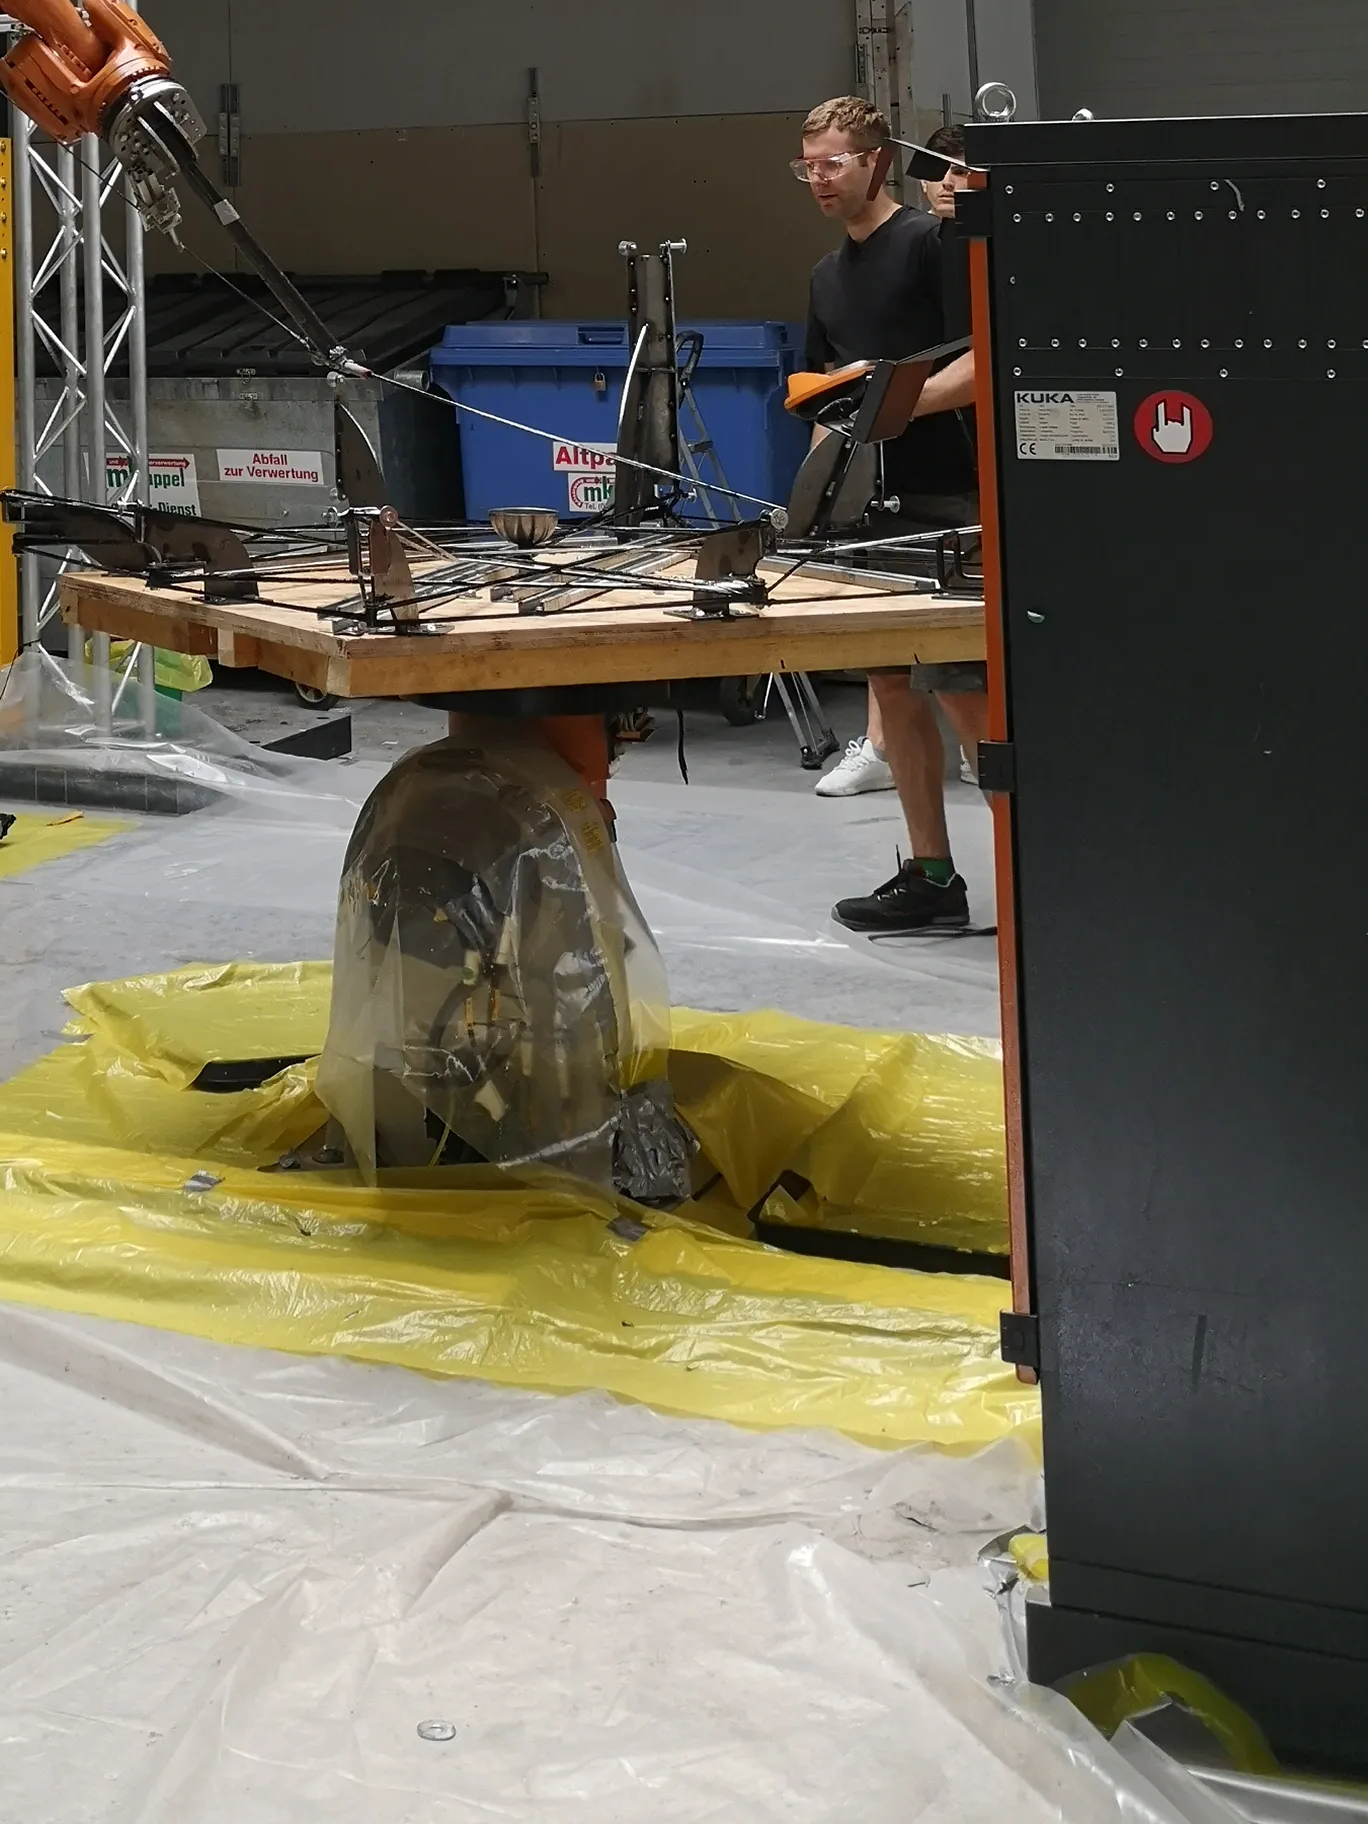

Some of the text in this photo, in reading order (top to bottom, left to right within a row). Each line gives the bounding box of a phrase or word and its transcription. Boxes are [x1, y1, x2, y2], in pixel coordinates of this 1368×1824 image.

[1016, 392, 1074, 404] KUKA
[252, 453, 288, 466] Abfall
[224, 465, 319, 483] zur Verwertung
